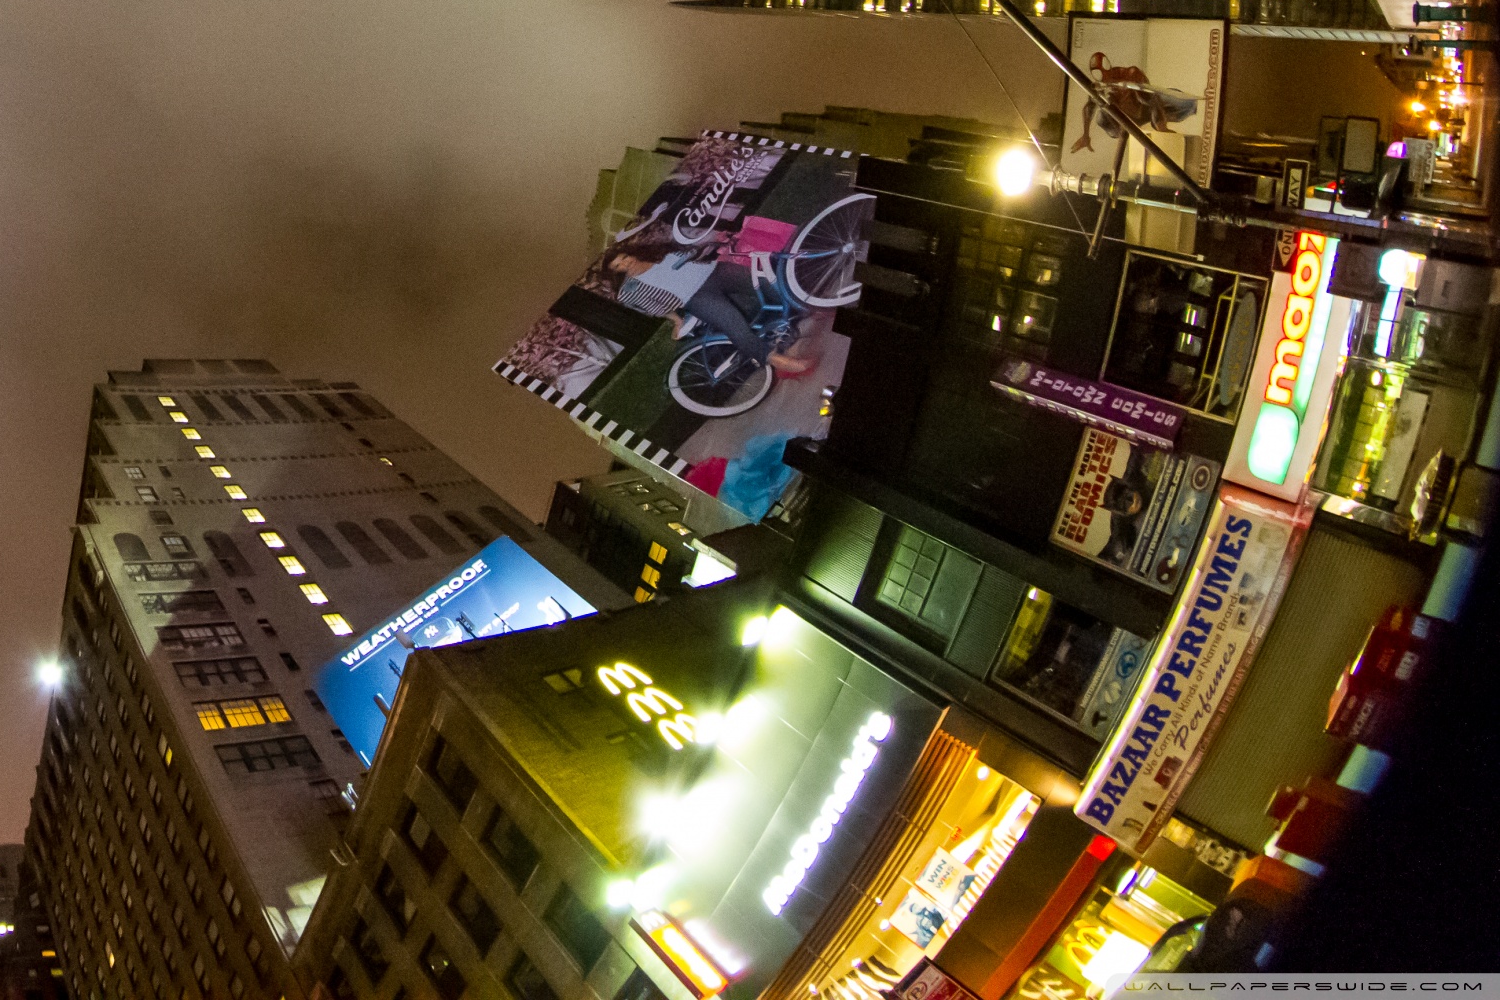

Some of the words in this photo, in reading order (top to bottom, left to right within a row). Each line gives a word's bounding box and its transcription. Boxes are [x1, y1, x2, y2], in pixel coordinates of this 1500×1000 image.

[672, 147, 754, 245] Candie's
[1030, 370, 1107, 405] MIDTOWN
[1111, 397, 1177, 427] COMICS
[1057, 511, 1071, 536] SEE
[1068, 481, 1082, 505] THE
[1078, 431, 1098, 477] MOVIE
[1064, 481, 1093, 540] READ
[1087, 432, 1108, 474] THE
[1074, 437, 1118, 544] COMICS
[1085, 700, 1170, 826] BAZAAR
[1155, 512, 1254, 702] PERFUMES
[1142, 755, 1158, 775] We
[1153, 728, 1175, 758] Carry
[1168, 711, 1182, 727] All
[1177, 681, 1197, 711] Kinds
[1193, 668, 1204, 681] of
[1199, 632, 1221, 668] Name
[1172, 640, 1238, 750] Perfumes
[927, 858, 948, 885] WIN
